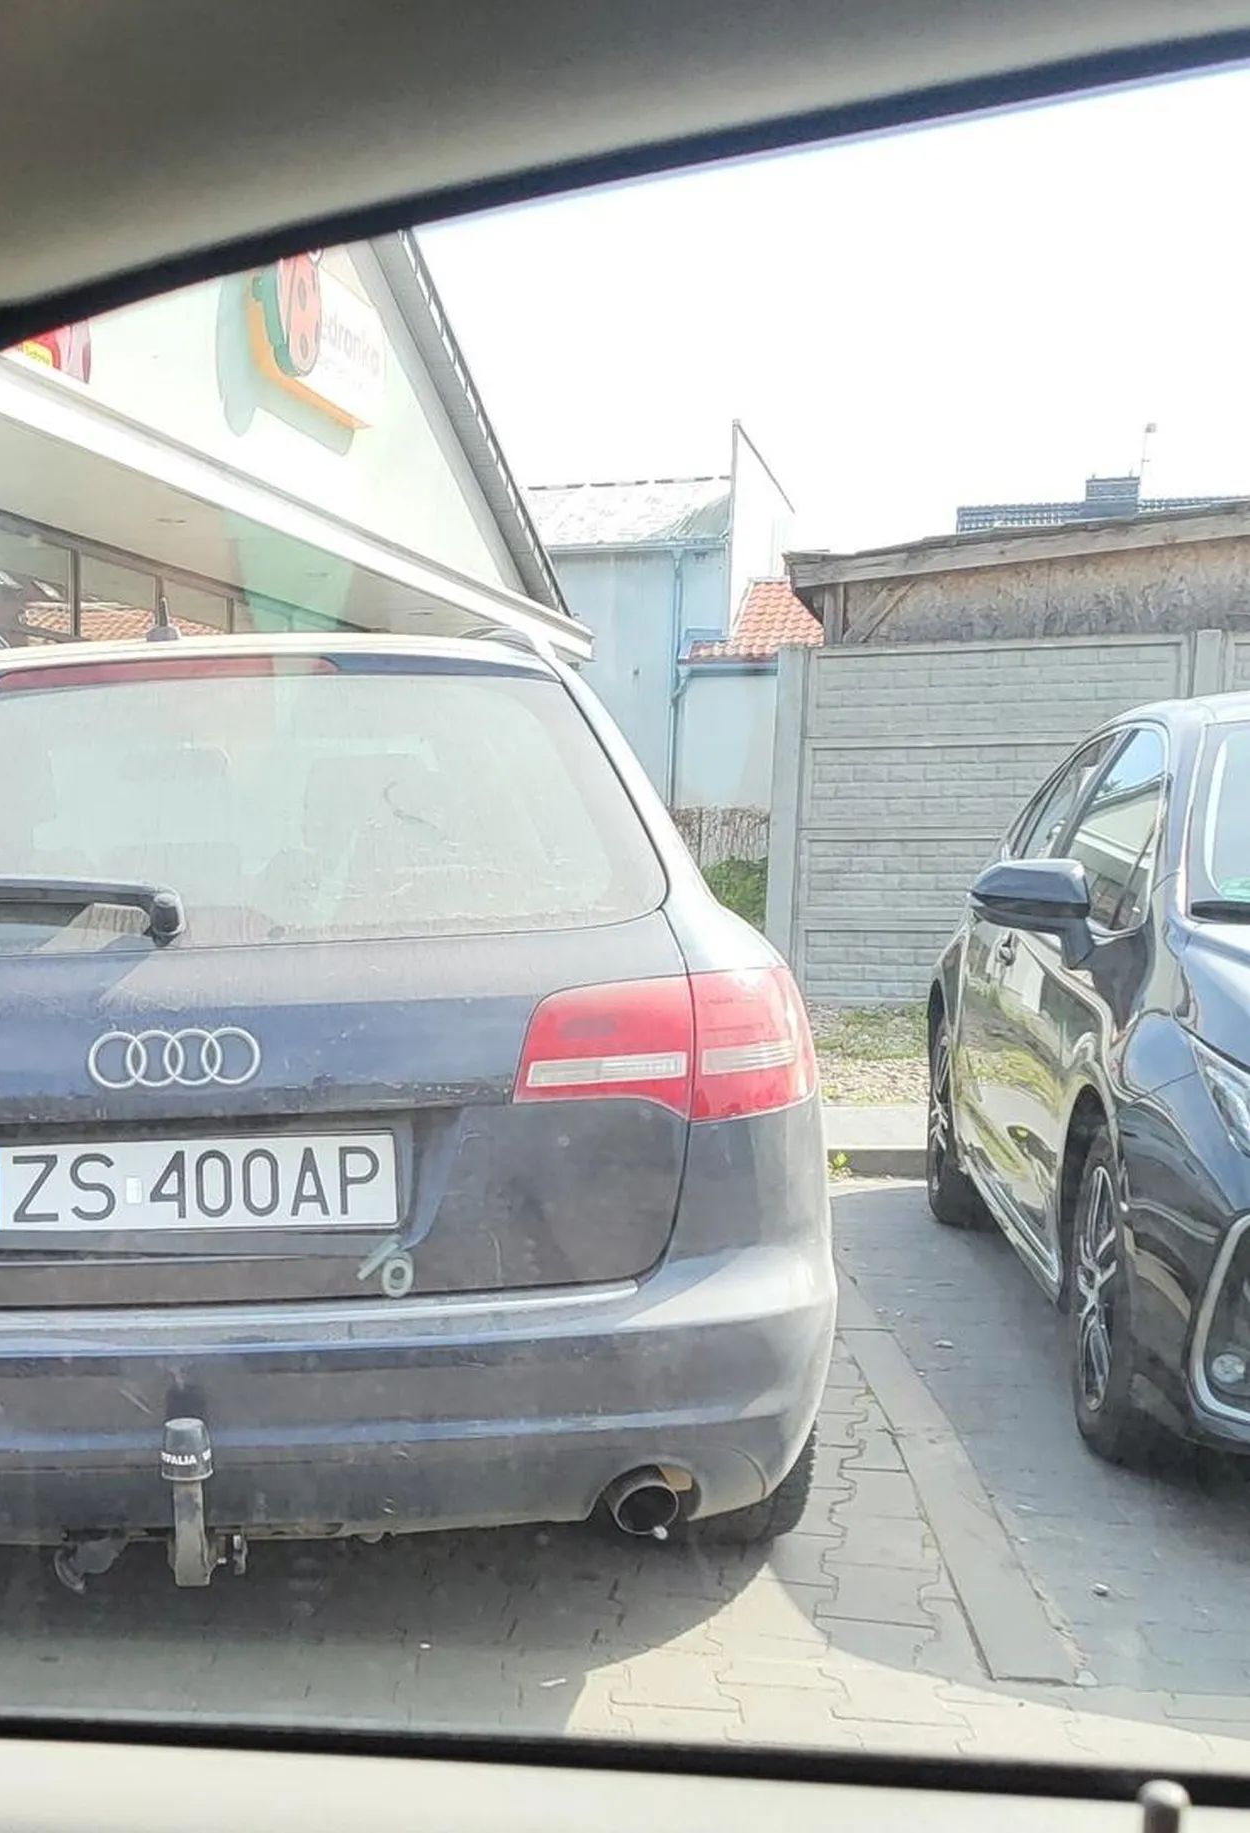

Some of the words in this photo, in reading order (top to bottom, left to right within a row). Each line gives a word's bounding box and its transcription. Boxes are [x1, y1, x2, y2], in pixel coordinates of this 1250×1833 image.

[322, 311, 380, 377] dronka
[11, 1153, 116, 1223] ZS
[149, 1146, 380, 1220] 400AP
